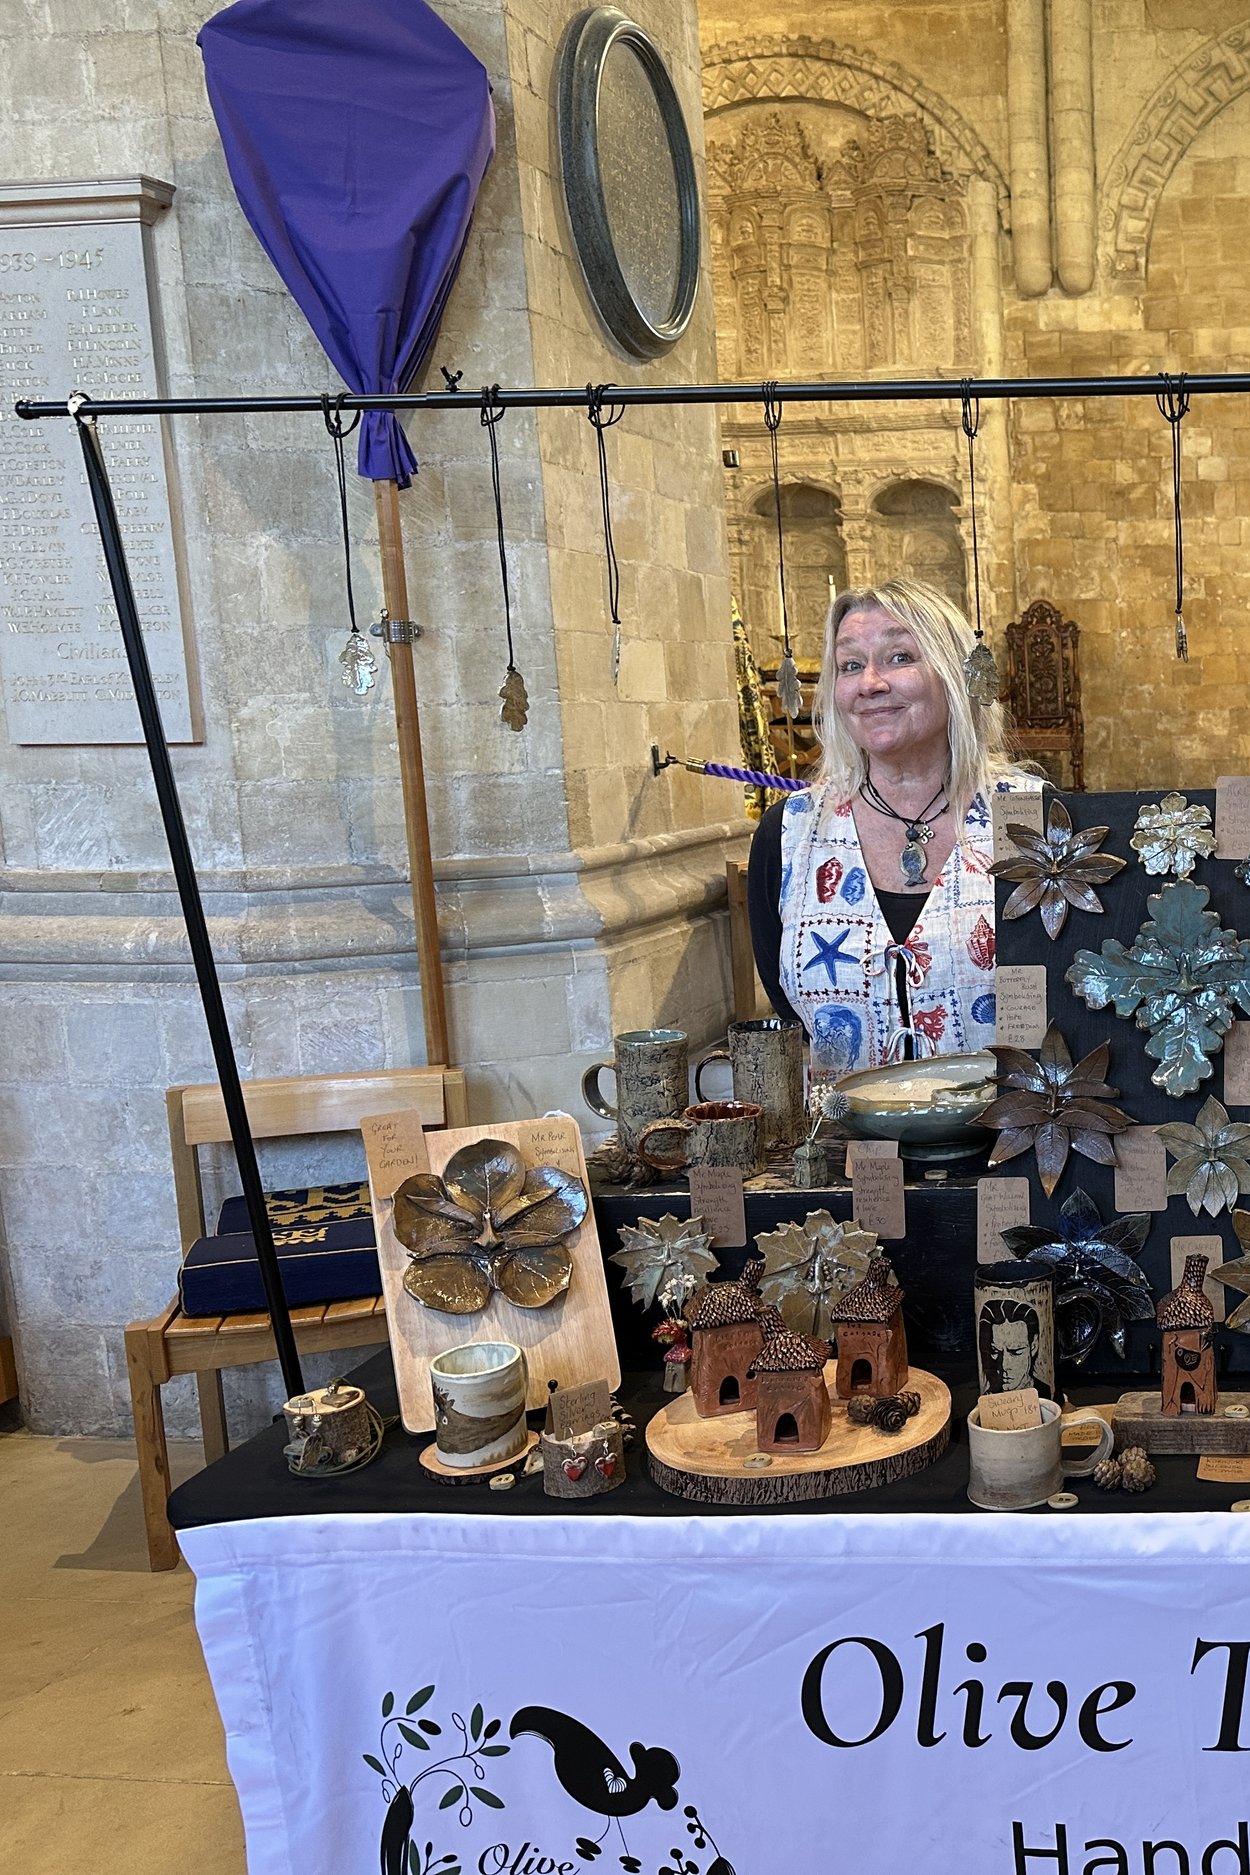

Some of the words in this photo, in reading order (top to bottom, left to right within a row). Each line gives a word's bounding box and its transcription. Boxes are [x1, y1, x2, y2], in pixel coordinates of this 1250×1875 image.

[801, 1622, 1137, 1753] Olive
[478, 1842, 581, 1875] Olive
[1012, 1821, 1250, 1875] Hand
